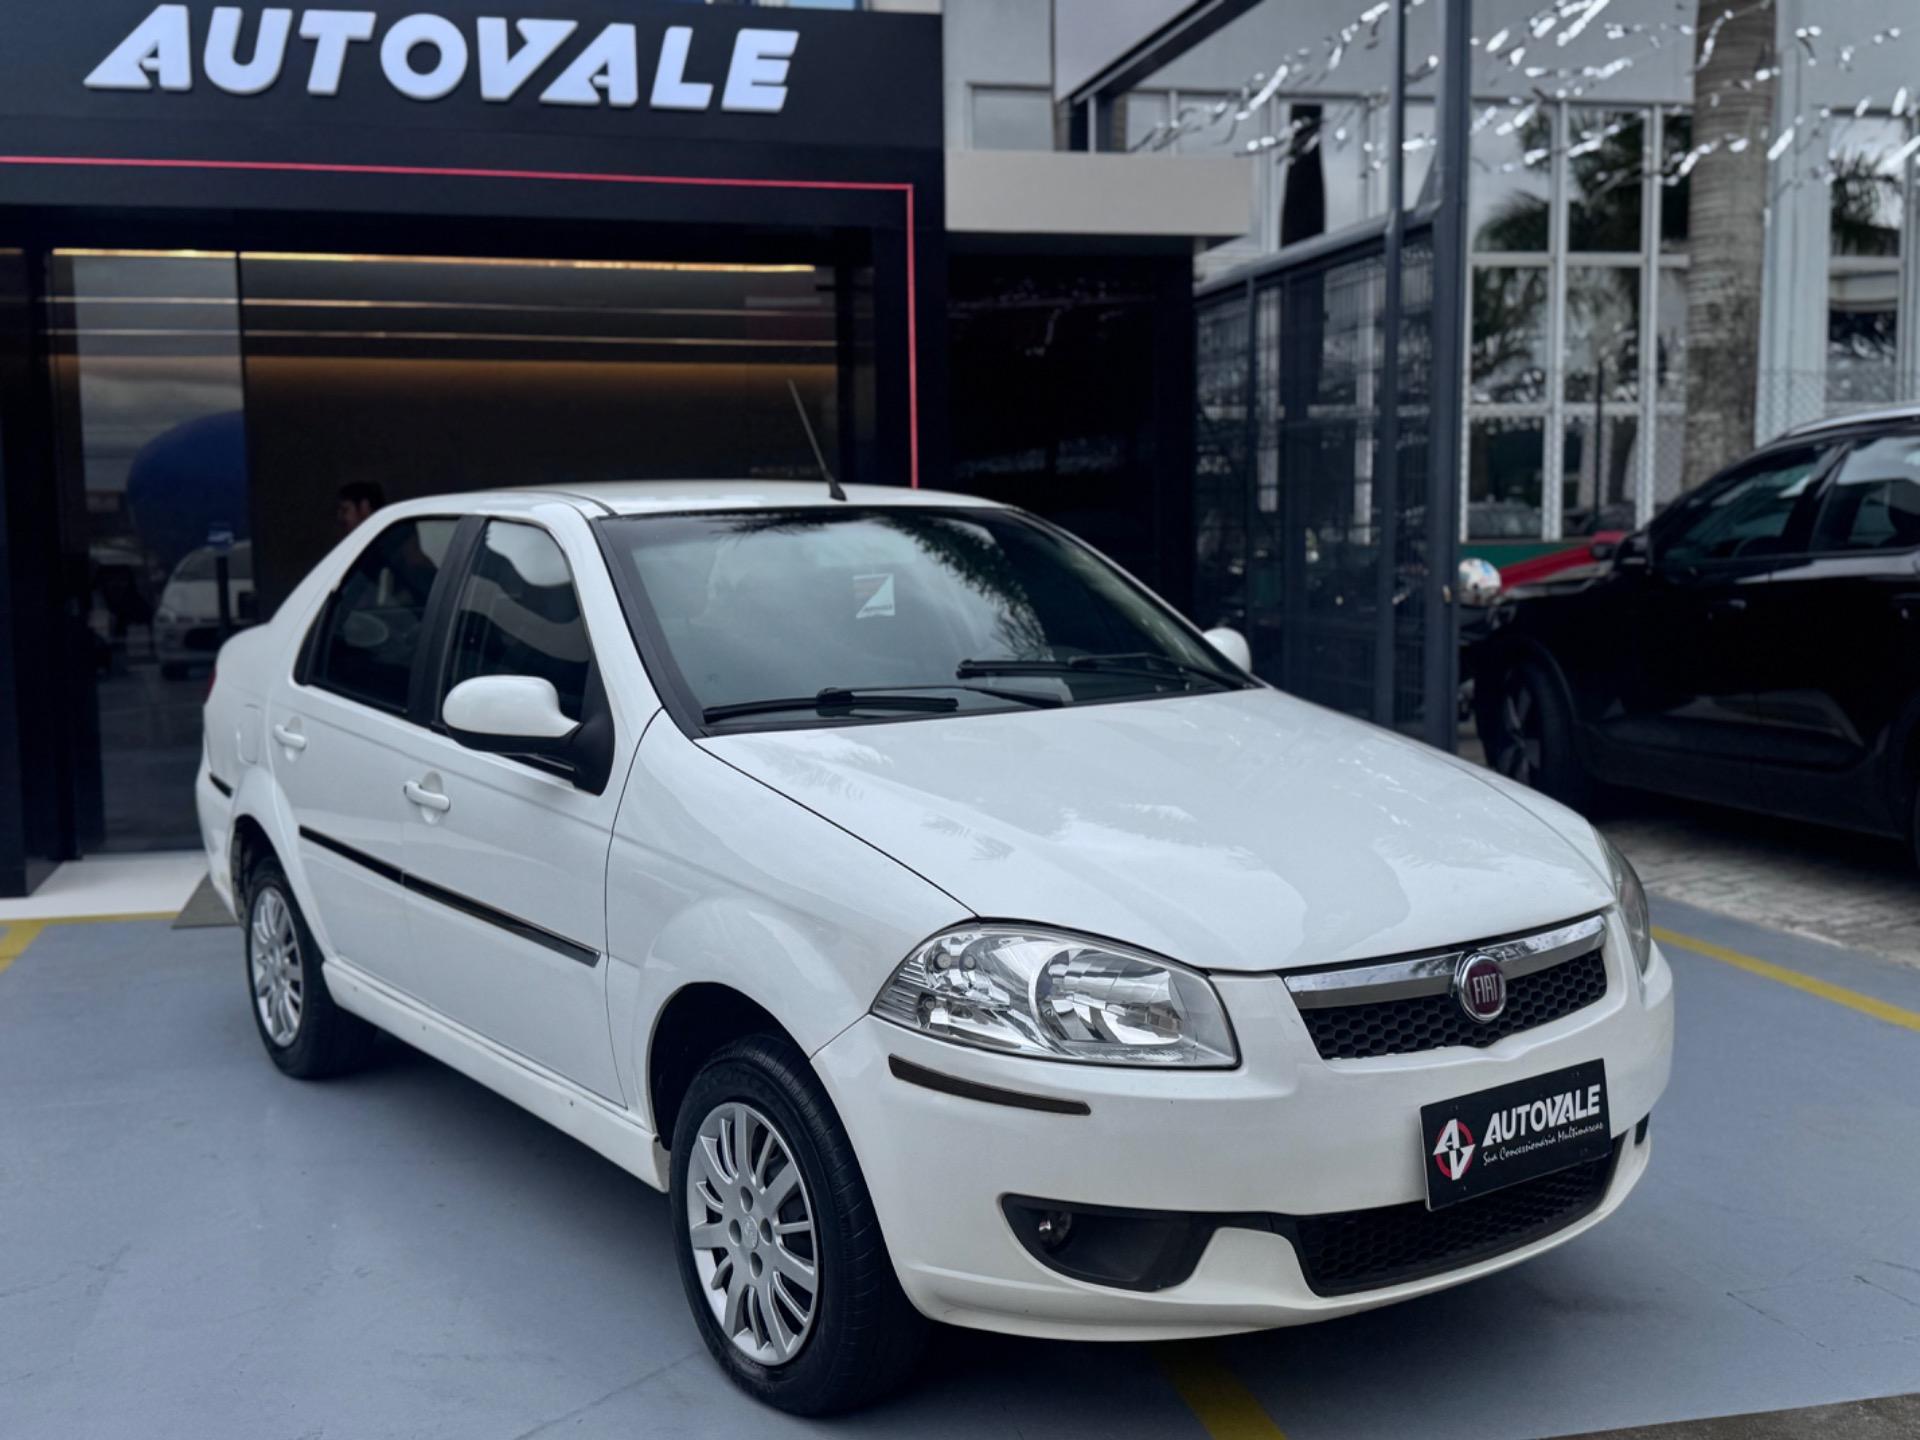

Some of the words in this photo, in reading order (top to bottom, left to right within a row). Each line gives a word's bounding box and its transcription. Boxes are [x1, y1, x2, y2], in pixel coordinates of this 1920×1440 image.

[84, 4, 799, 112] AUTOVALE
[1472, 972, 1499, 1004] FIAT
[1482, 1084, 1600, 1147] AUTOVALE
